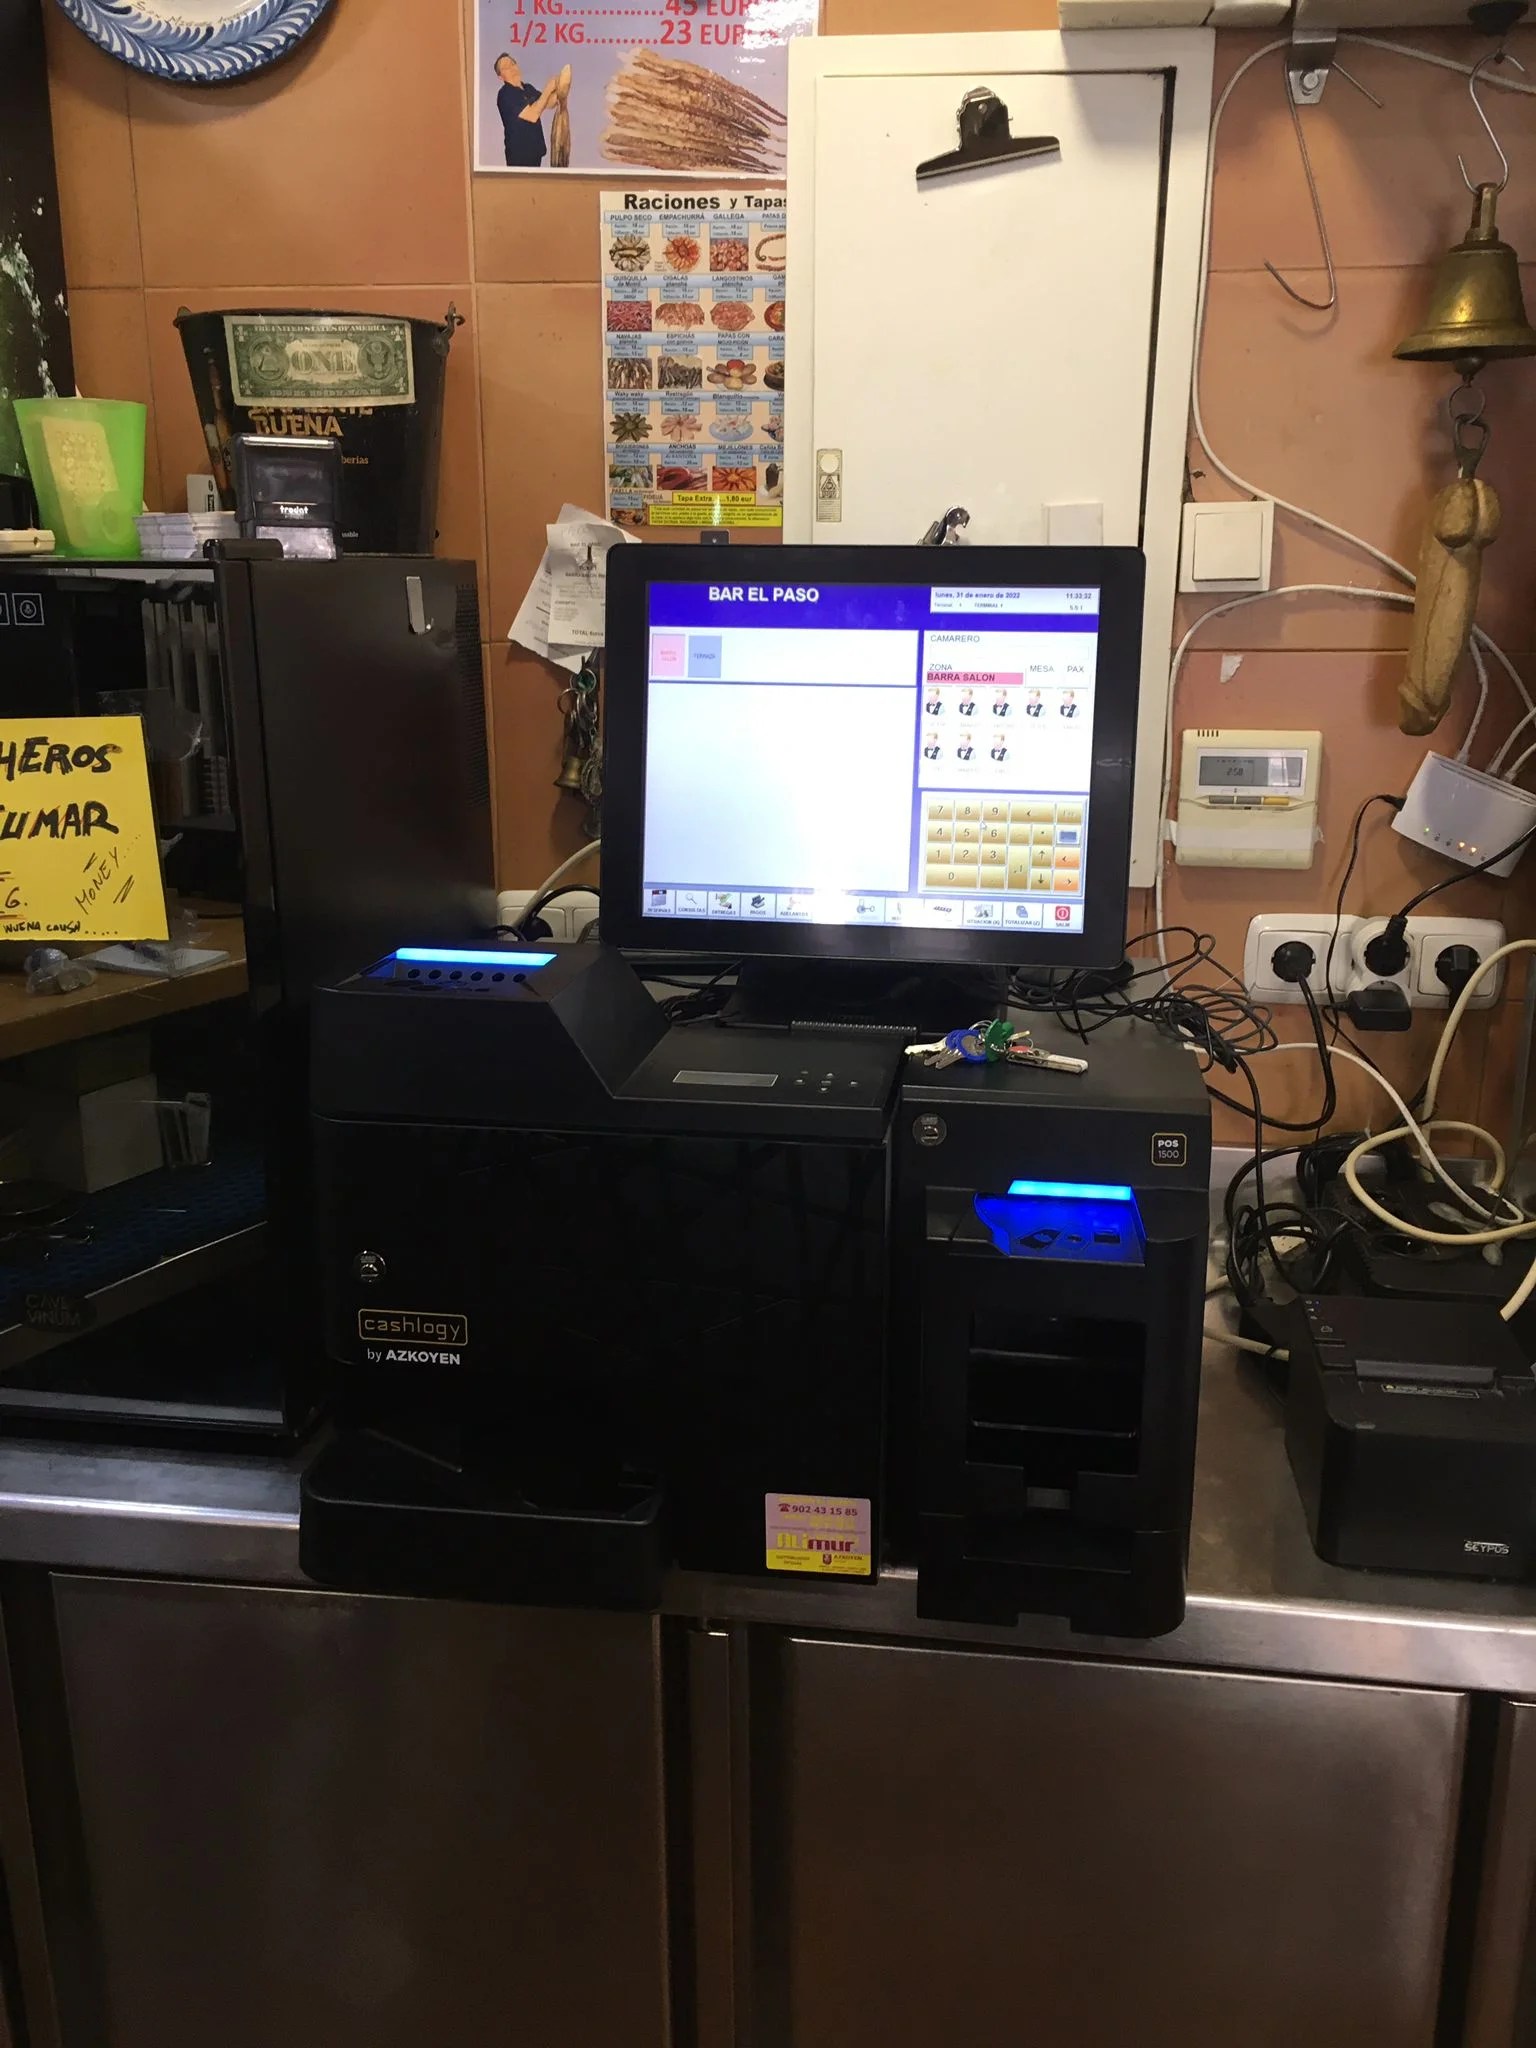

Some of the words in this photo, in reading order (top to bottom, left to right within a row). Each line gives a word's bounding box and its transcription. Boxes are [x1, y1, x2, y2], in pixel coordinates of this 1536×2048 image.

[510, 20, 547, 47] 1/2
[624, 193, 720, 210] Raciones
[730, 197, 737, 209] y
[272, 325, 303, 333] UNITED
[304, 325, 336, 333] STATES
[290, 349, 358, 375] ONE
[252, 415, 344, 437] BUENA
[677, 494, 693, 503] Tapa
[279, 505, 309, 514] trodat
[708, 586, 744, 602] BAR
[747, 587, 769, 602] EL
[772, 587, 820, 603] PASO
[935, 592, 955, 600] lunes,
[930, 634, 980, 643] CAMARERO
[928, 663, 953, 671] ZONA
[1029, 665, 1055, 673] MESA
[1067, 665, 1085, 673] PAX
[926, 673, 961, 682] BARRA
[962, 674, 996, 682] SALON
[936, 805, 944, 814] 7
[964, 806, 971, 815] 8
[991, 807, 999, 815] 9
[0, 801, 119, 840] UMAR
[936, 828, 943, 836] 4
[963, 828, 970, 837] 5
[991, 829, 998, 838] 6
[962, 850, 969, 858] 2
[990, 850, 997, 859] 3
[1157, 1139, 1179, 1148] POS
[1158, 1149, 1180, 1159] 1500
[364, 1316, 460, 1341] cashlogy
[367, 1348, 382, 1363] by
[385, 1349, 461, 1365] AZKOYEN
[792, 1506, 811, 1514] 902
[814, 1506, 826, 1514] 43
[830, 1507, 842, 1515] 15
[844, 1508, 858, 1516] 85
